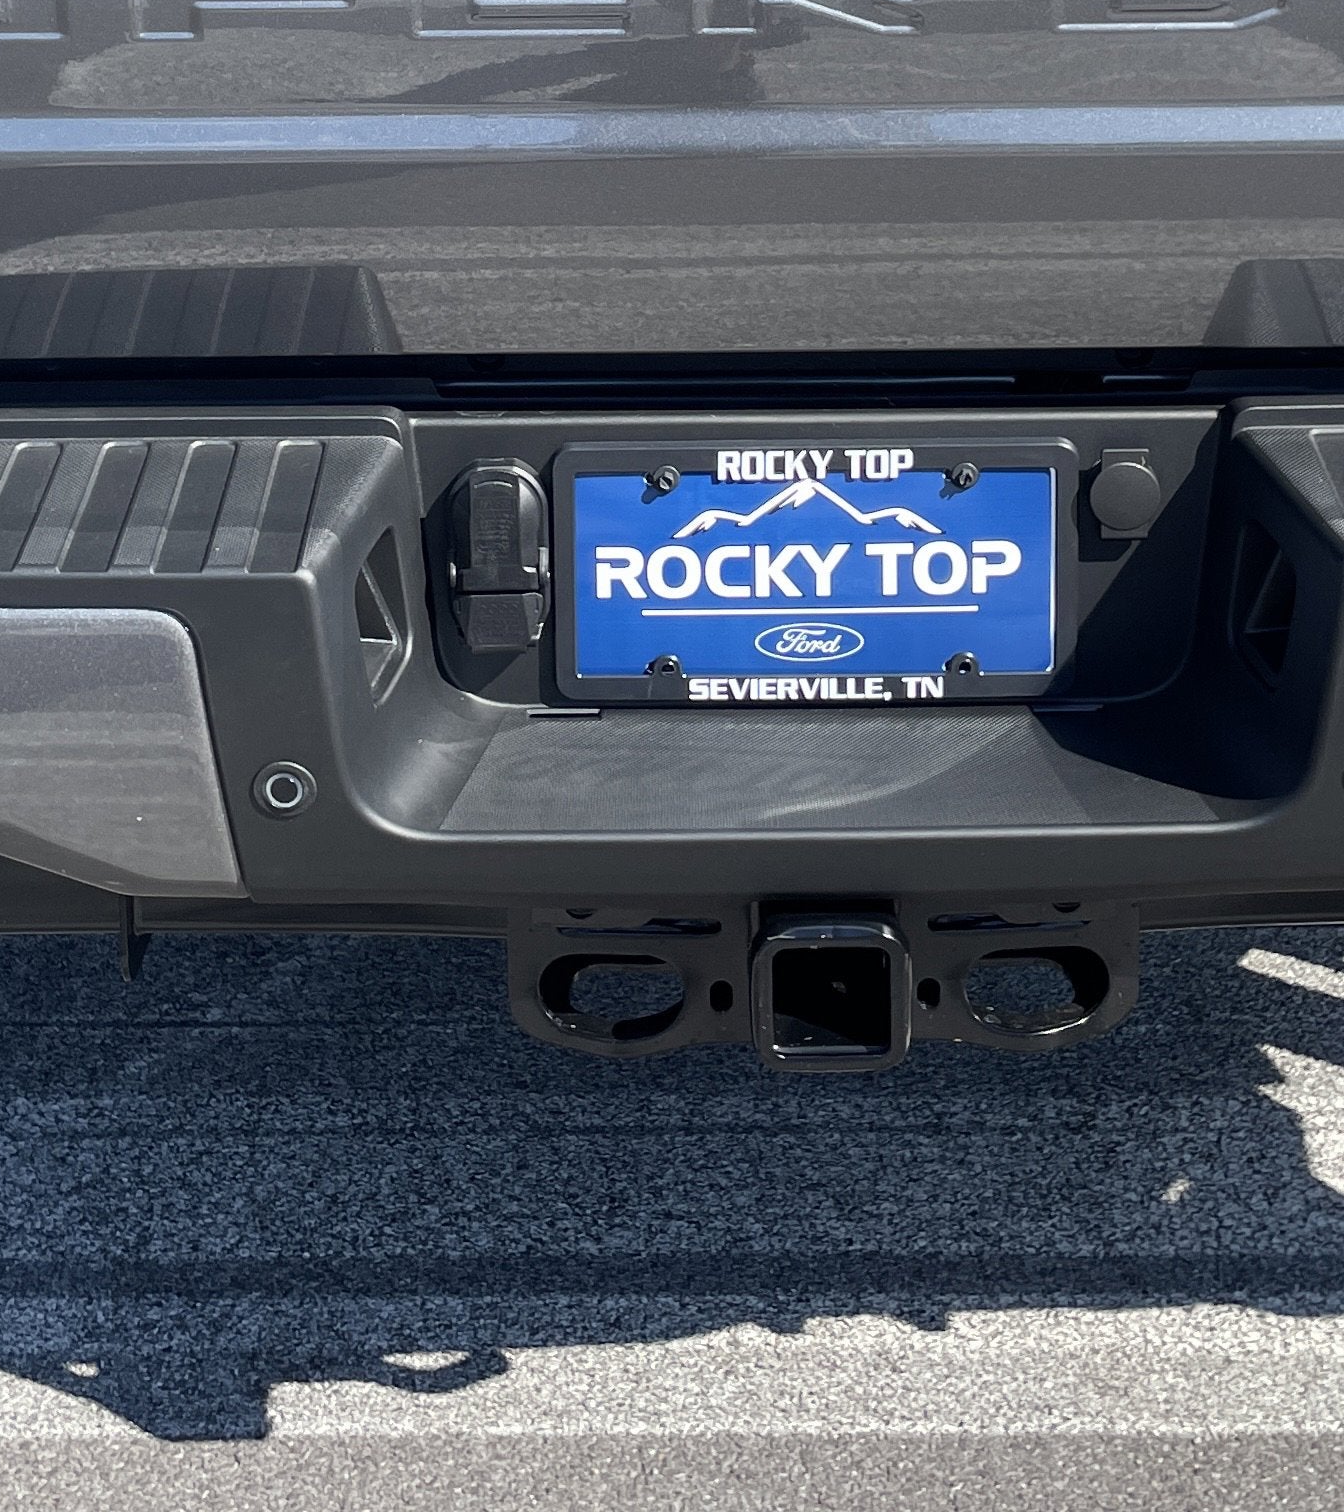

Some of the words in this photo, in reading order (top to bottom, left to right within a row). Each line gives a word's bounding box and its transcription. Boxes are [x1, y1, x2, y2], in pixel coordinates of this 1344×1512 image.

[717, 449, 834, 482] ROCKY
[843, 448, 914, 480] TOP
[595, 543, 851, 600] ROCKY
[864, 539, 1023, 597] TOP
[775, 627, 842, 655] Ford
[688, 676, 893, 702] SEVIERVILLE,
[900, 675, 945, 699] TN
